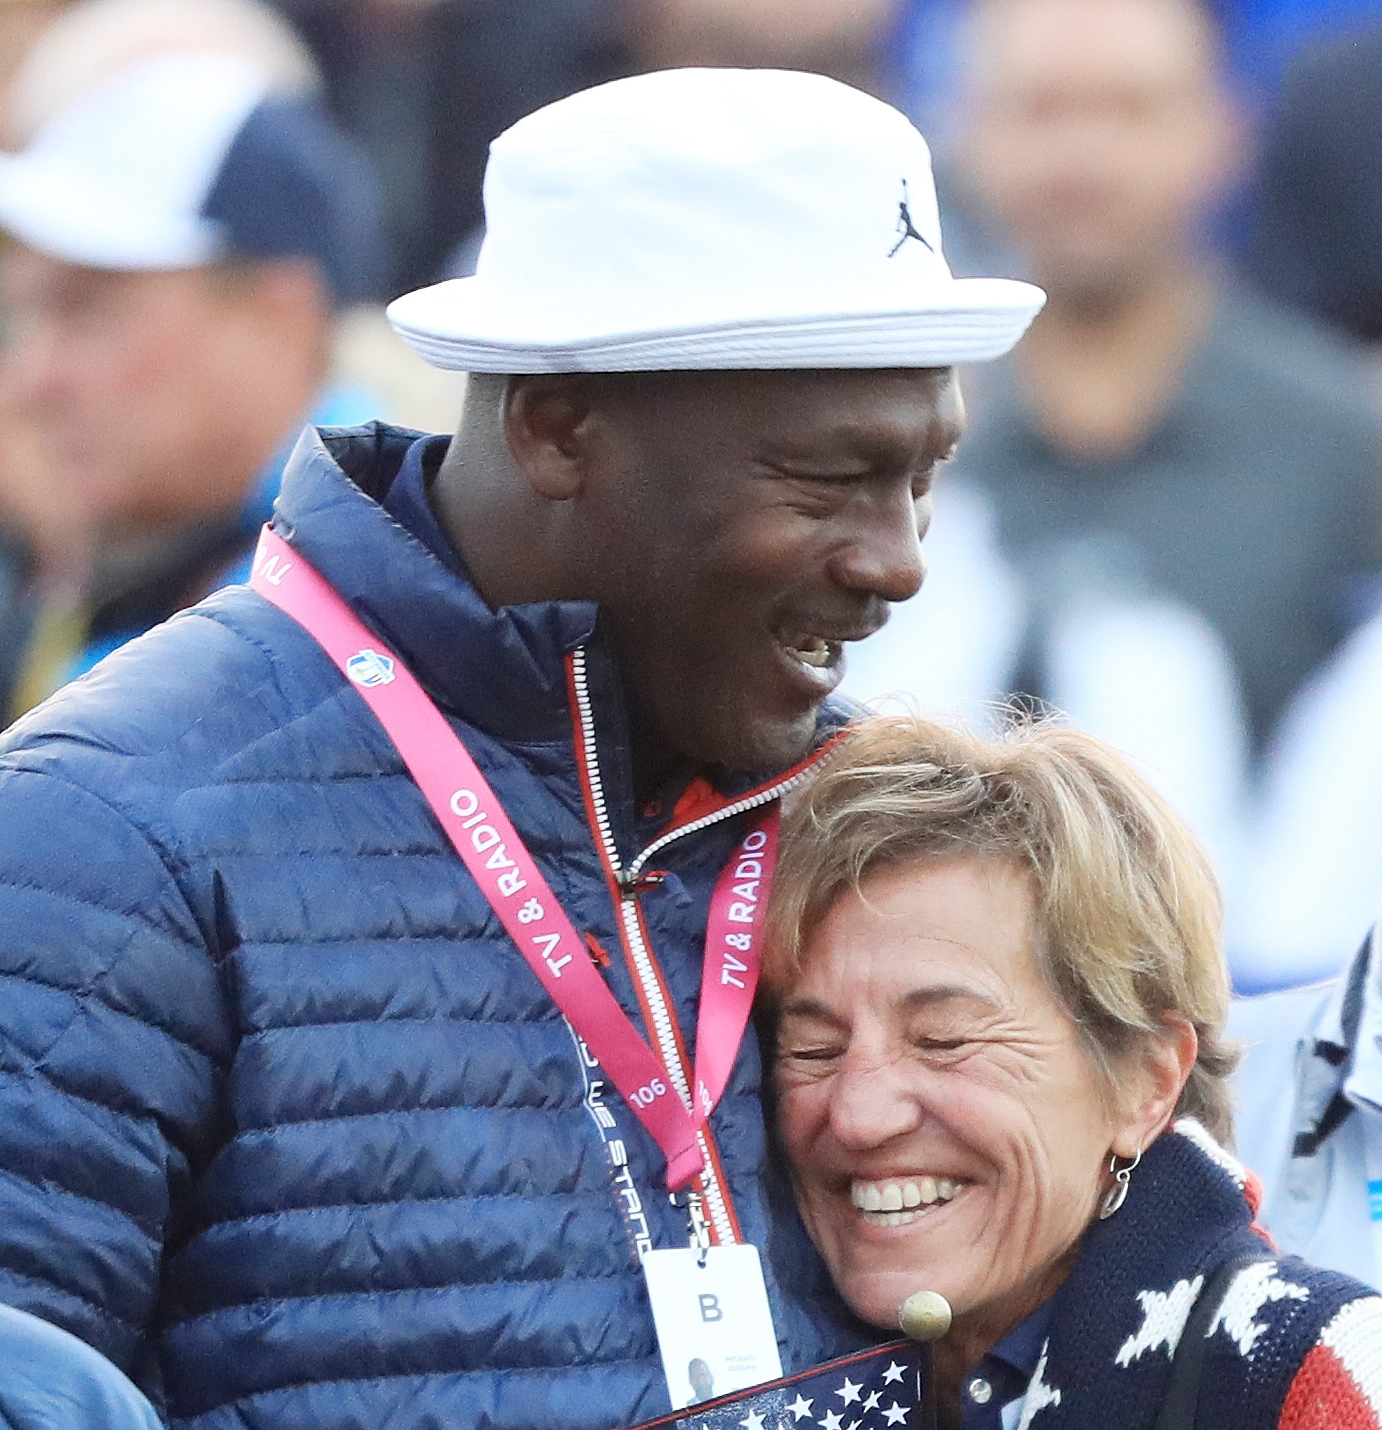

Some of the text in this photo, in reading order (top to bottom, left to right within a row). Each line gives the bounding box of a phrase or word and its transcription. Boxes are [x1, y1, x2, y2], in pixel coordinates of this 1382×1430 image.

[259, 555, 292, 585] TV
[450, 789, 573, 978] TV & RADIO
[721, 830, 768, 989] TV & RADIO
[629, 1077, 667, 1109] 106
[698, 1293, 723, 1322] B
